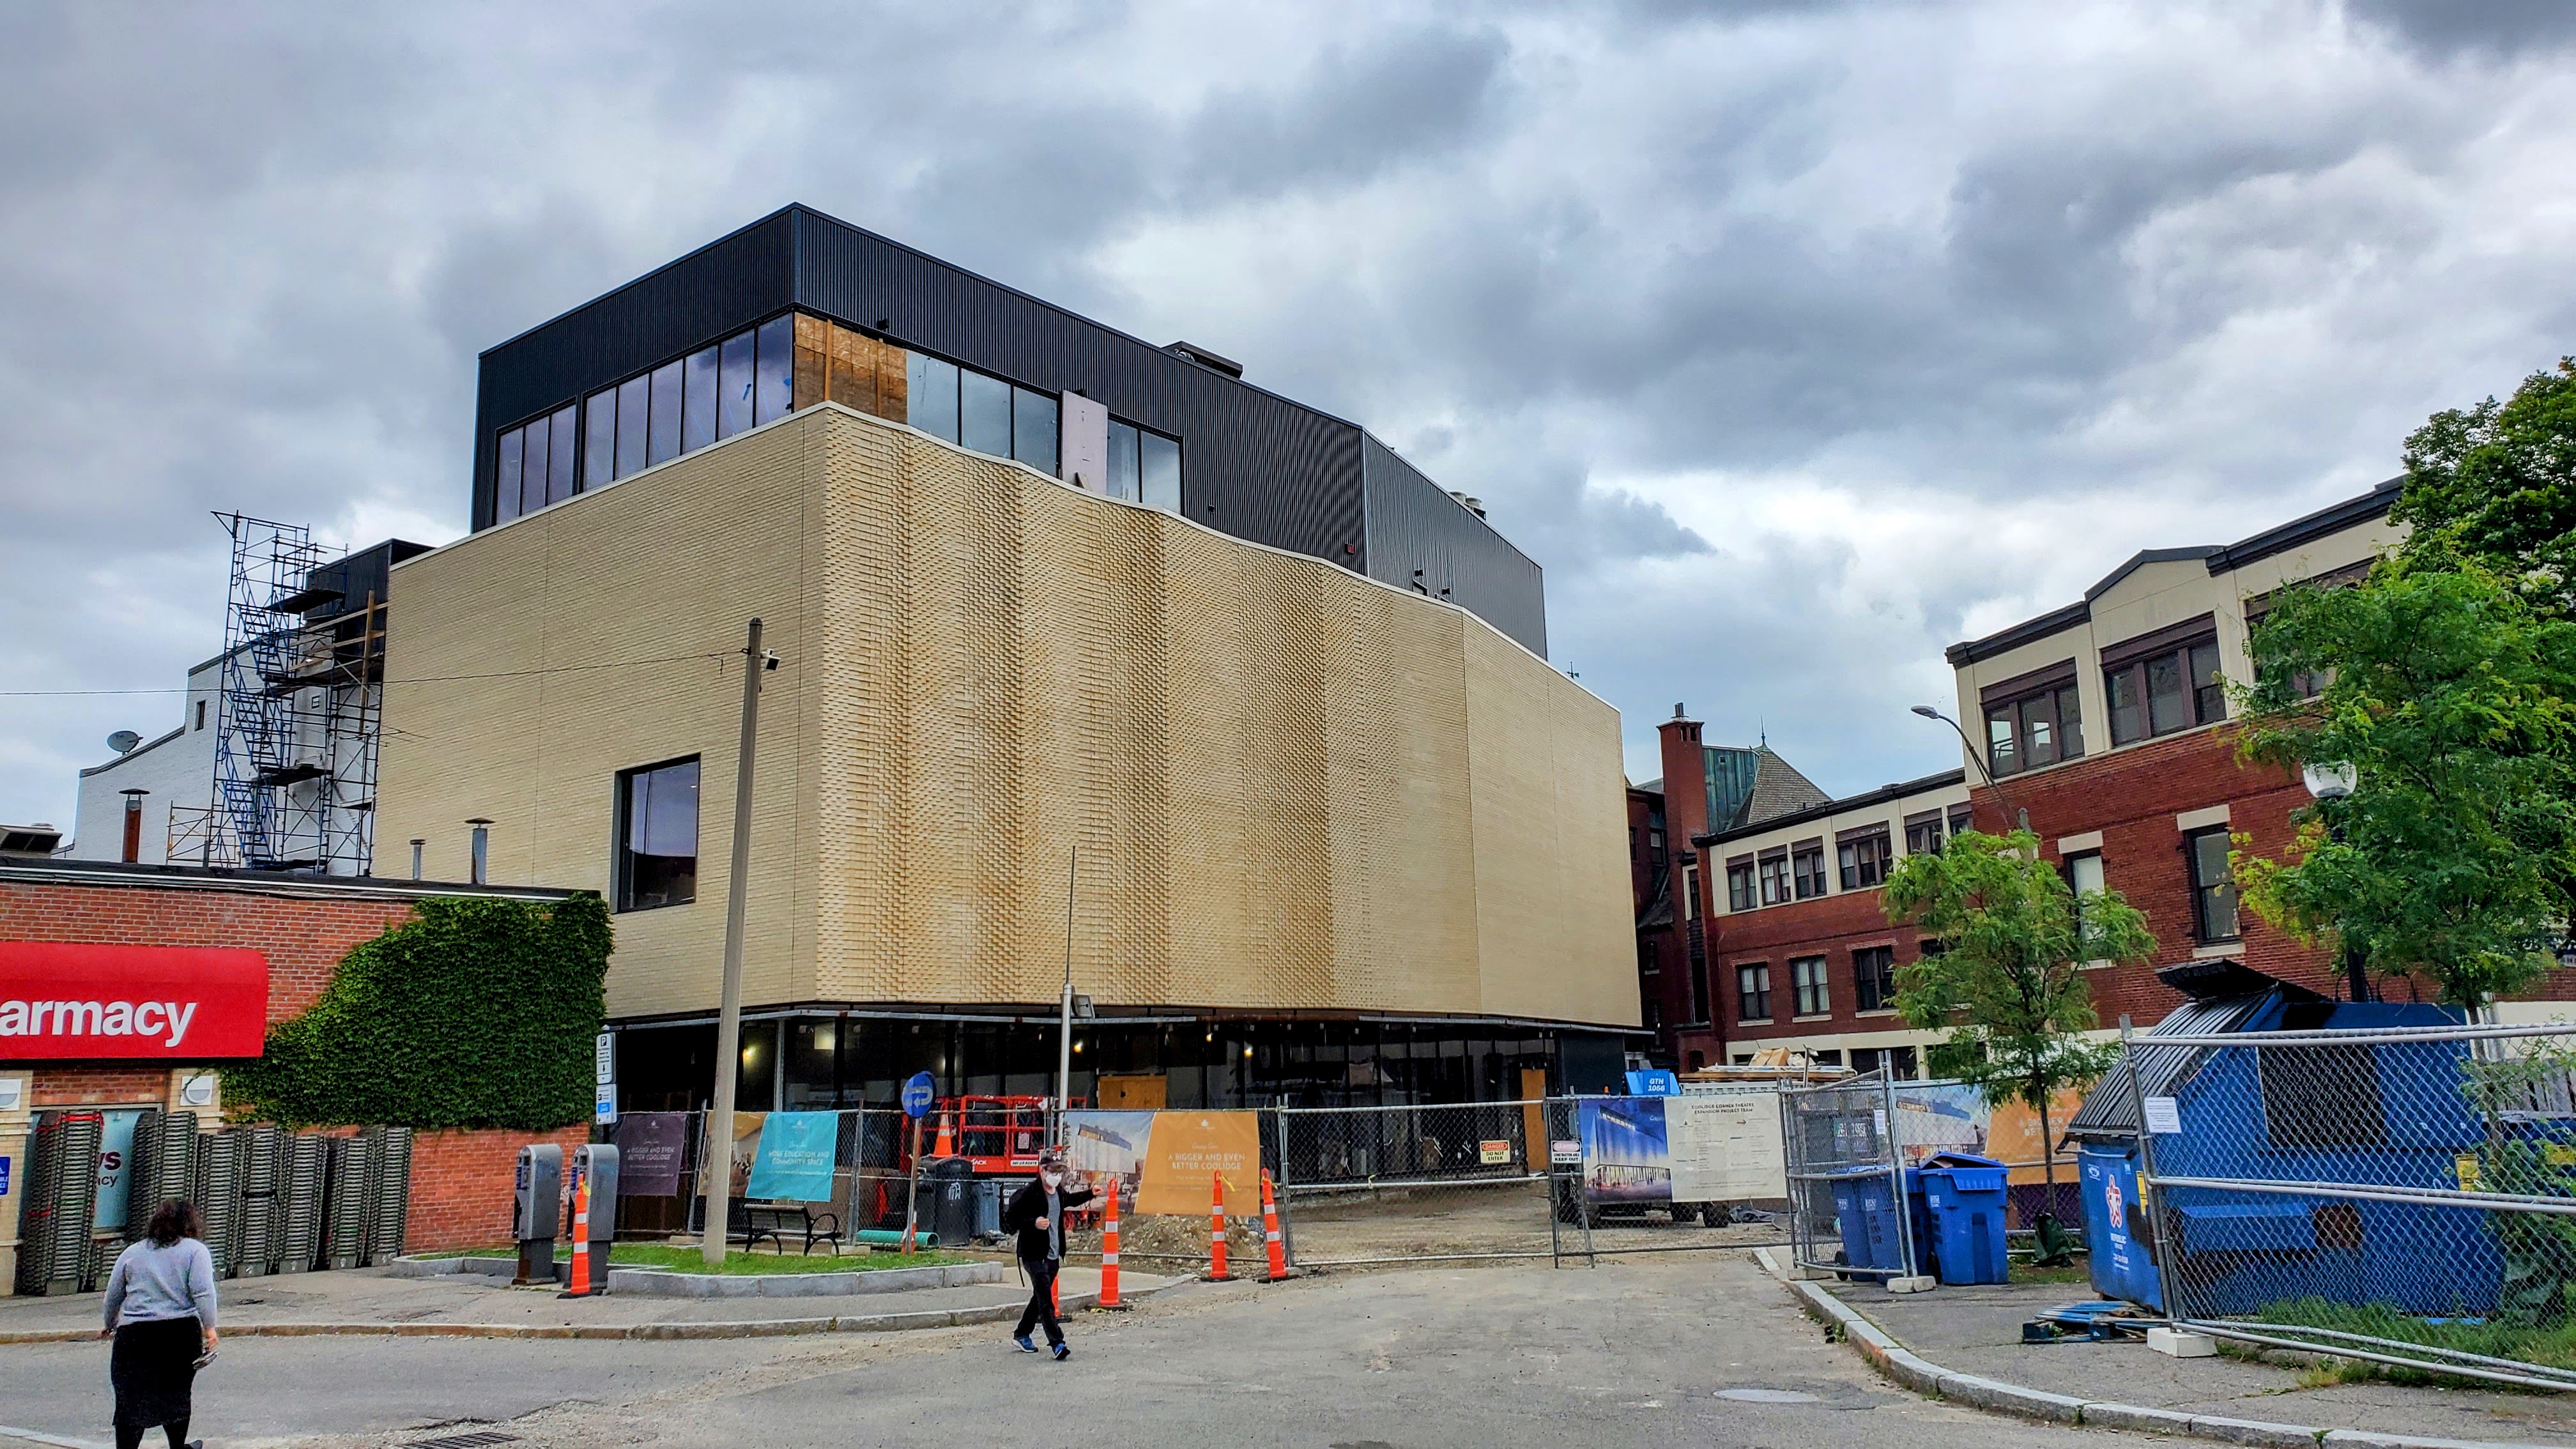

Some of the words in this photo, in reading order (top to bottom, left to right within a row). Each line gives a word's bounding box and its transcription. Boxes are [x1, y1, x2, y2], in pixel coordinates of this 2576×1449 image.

[0, 1000, 197, 1048] armacy
[1223, 1153, 1245, 1161] EVEN
[1200, 1162, 1241, 1170] COOLIDGE
